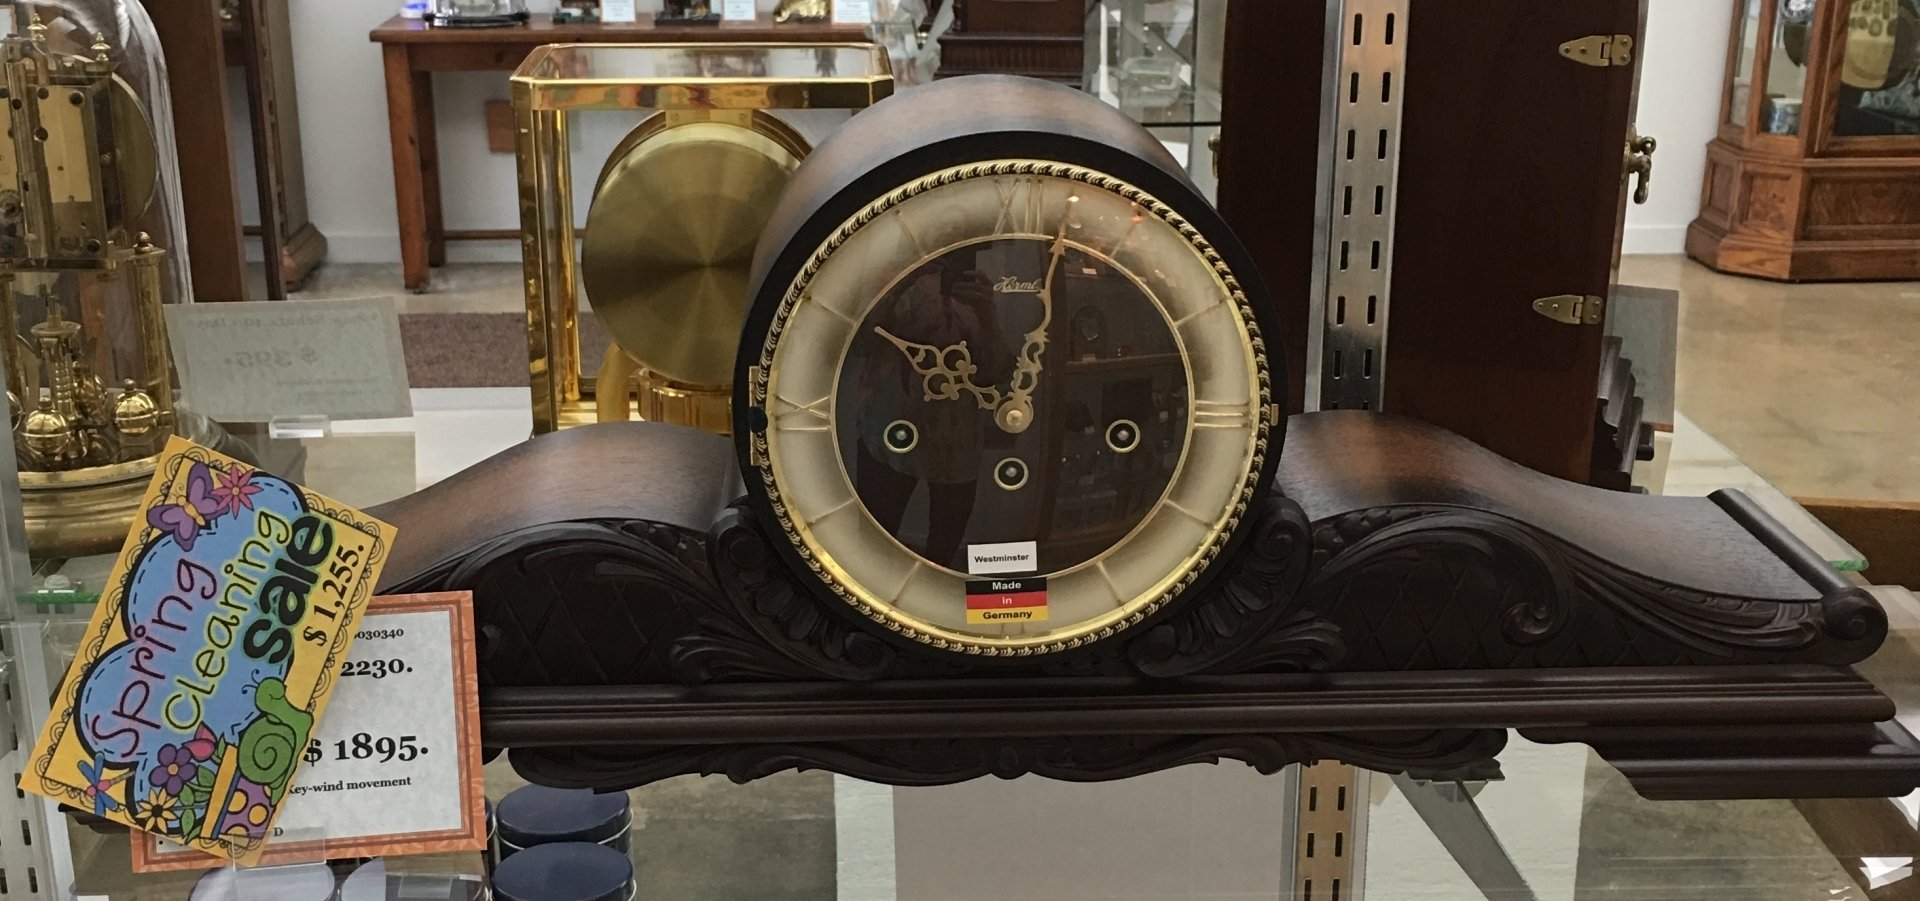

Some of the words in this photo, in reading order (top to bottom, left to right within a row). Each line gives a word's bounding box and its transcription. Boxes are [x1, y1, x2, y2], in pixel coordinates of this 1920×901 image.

[993, 276, 1044, 293] Herml
[974, 553, 1030, 563] Westminster
[313, 544, 365, 624] 1,255.
[992, 581, 1022, 591] Made
[164, 510, 290, 730] Cleaning
[982, 610, 1033, 620] Germany
[303, 626, 328, 647] $
[353, 628, 405, 641] 030340
[91, 558, 218, 758] Spring
[340, 658, 413, 679] 2230.
[303, 737, 323, 767] $
[334, 732, 429, 763] 1895.
[346, 776, 412, 791] movement
